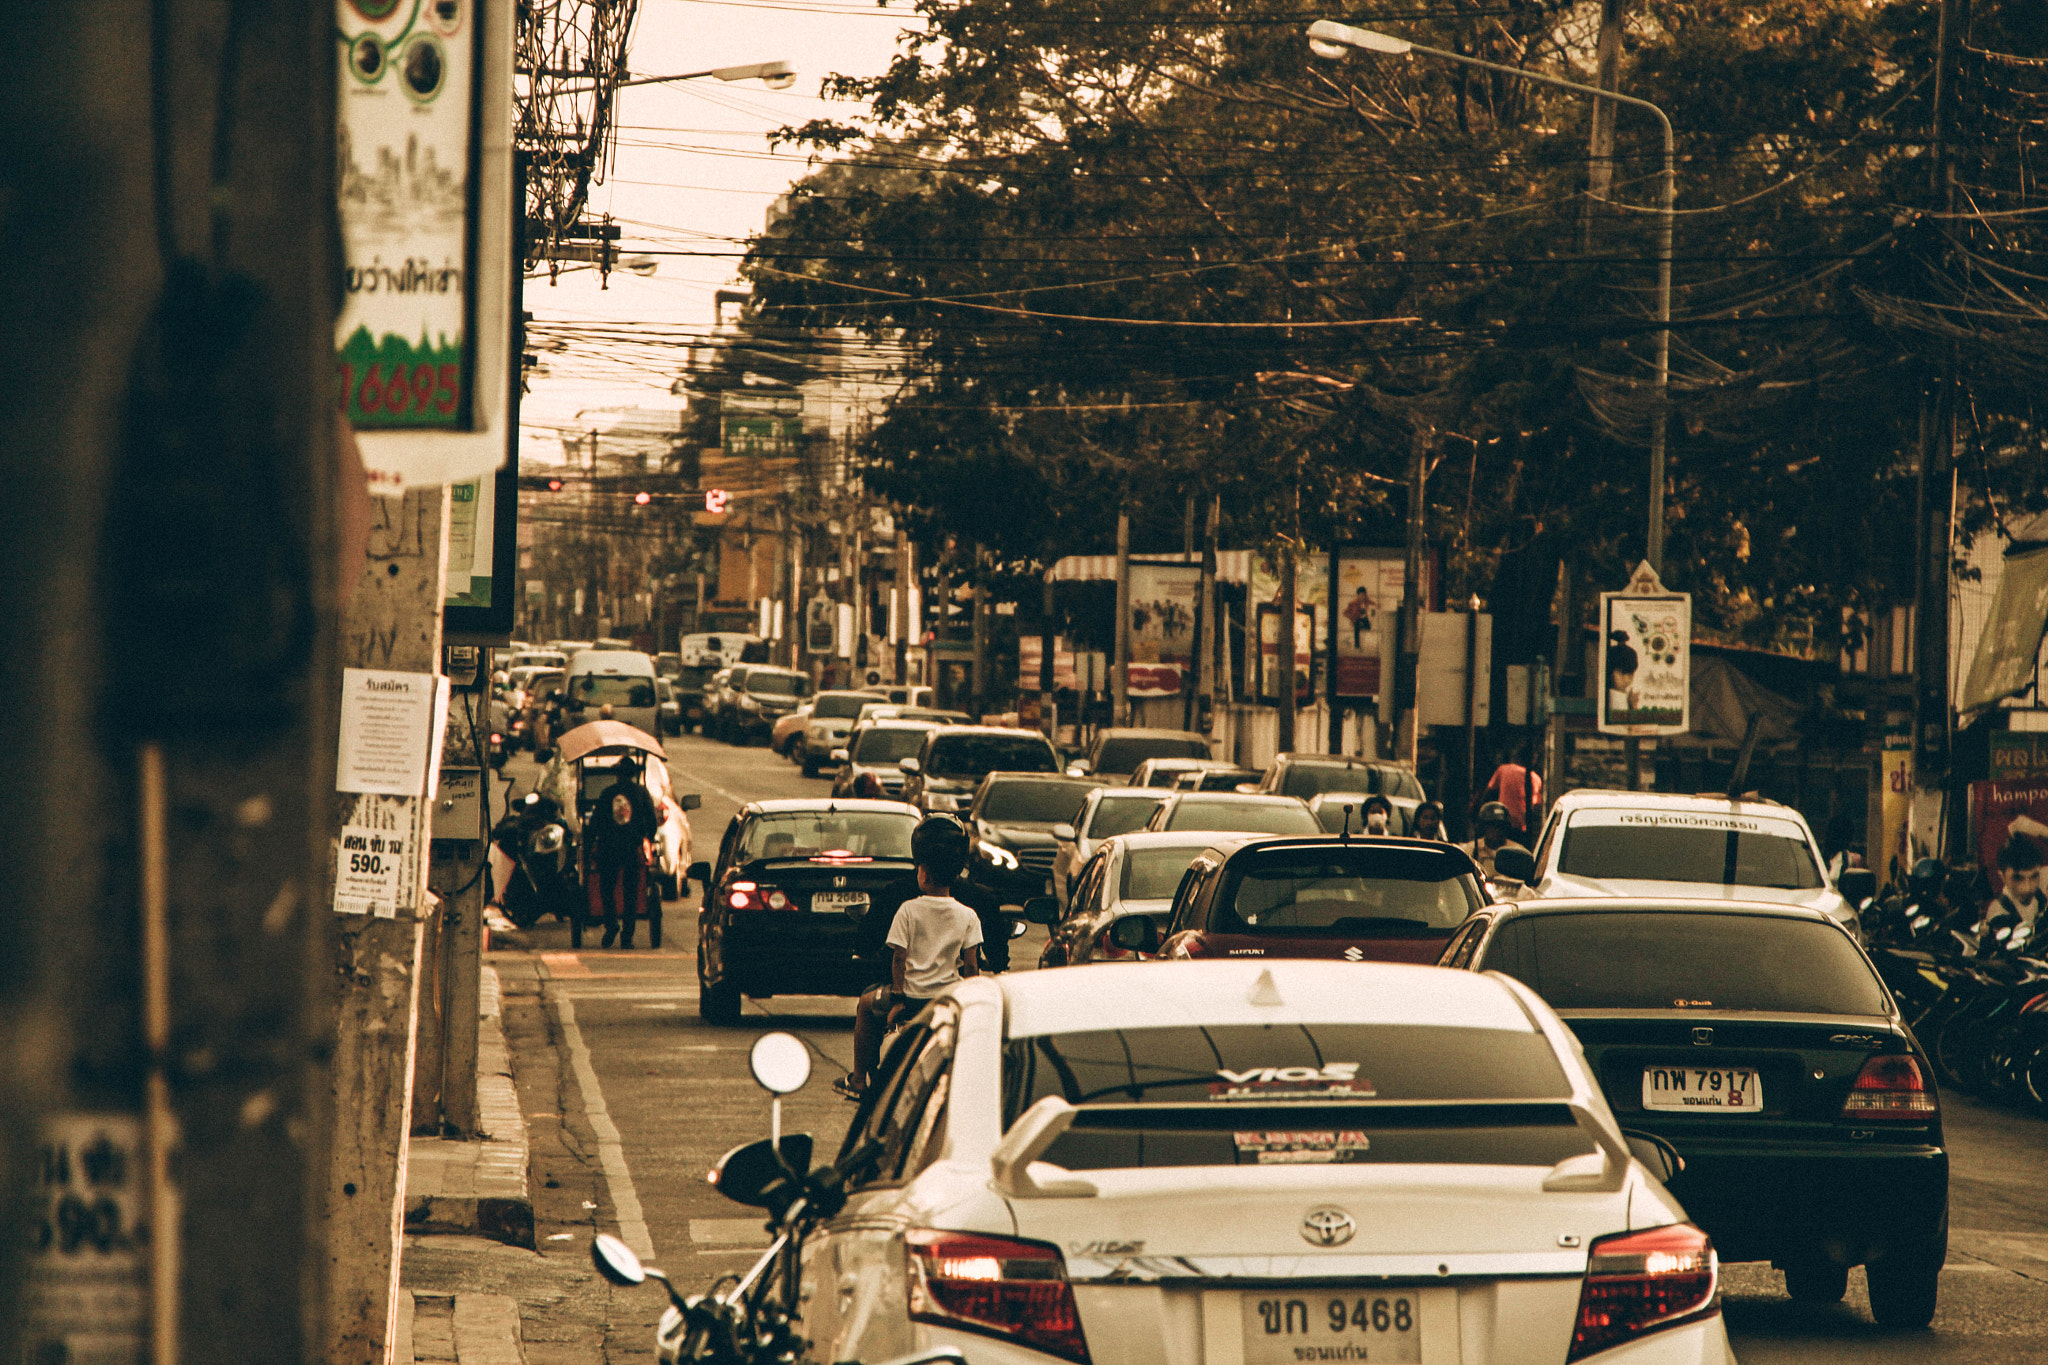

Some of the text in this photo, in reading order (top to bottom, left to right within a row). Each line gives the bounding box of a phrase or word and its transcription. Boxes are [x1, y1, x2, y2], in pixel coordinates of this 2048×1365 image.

[350, 853, 391, 875] 590.-
[1216, 1062, 1360, 1083] VIOS
[1653, 1069, 1750, 1092] กพ 7917
[1258, 1298, 1412, 1334] ขก 9468
[1293, 1341, 1368, 1361] ขอนแก่น
